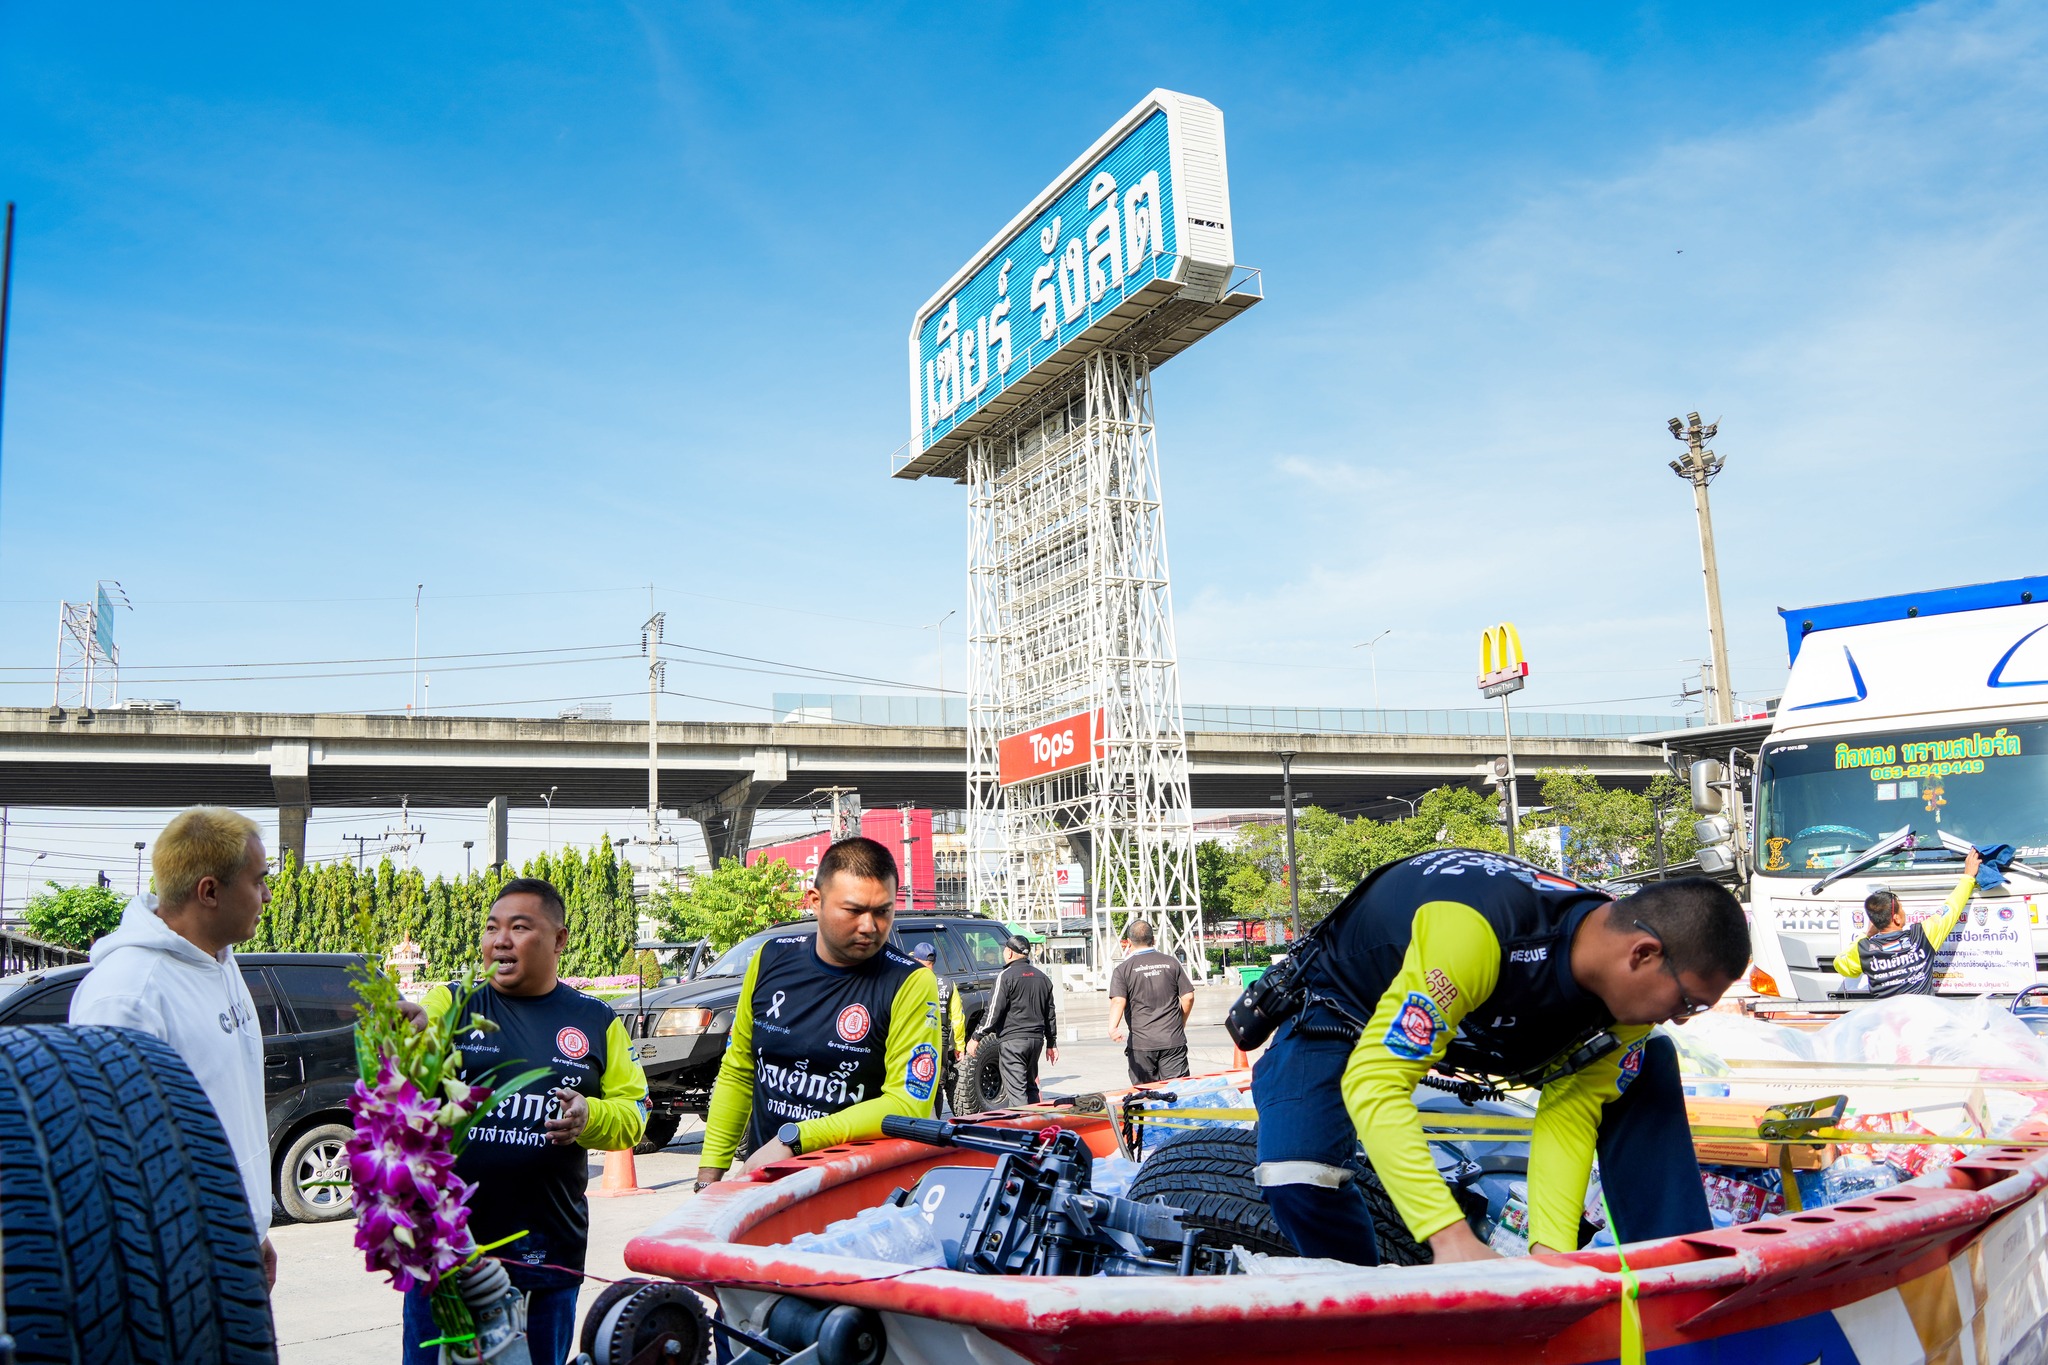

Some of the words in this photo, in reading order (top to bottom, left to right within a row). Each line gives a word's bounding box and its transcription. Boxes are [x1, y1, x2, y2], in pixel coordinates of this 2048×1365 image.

[927, 258, 1012, 428] เซียร์
[1031, 170, 1164, 340] รังสิต
[1029, 729, 1074, 767] Tops
[1835, 743, 1895, 769] กิจทอง
[1902, 728, 2020, 763] ทรานสปอร์ต
[1871, 760, 1983, 780] 063-2249449
[886, 950, 915, 966] RESCUE
[1430, 968, 1459, 1000] ASIA
[1411, 995, 1446, 1031] RESCUE
[756, 1048, 865, 1105] ป่อเต็กตึ๊ง
[467, 1125, 547, 1148] อาสาสมัคร
